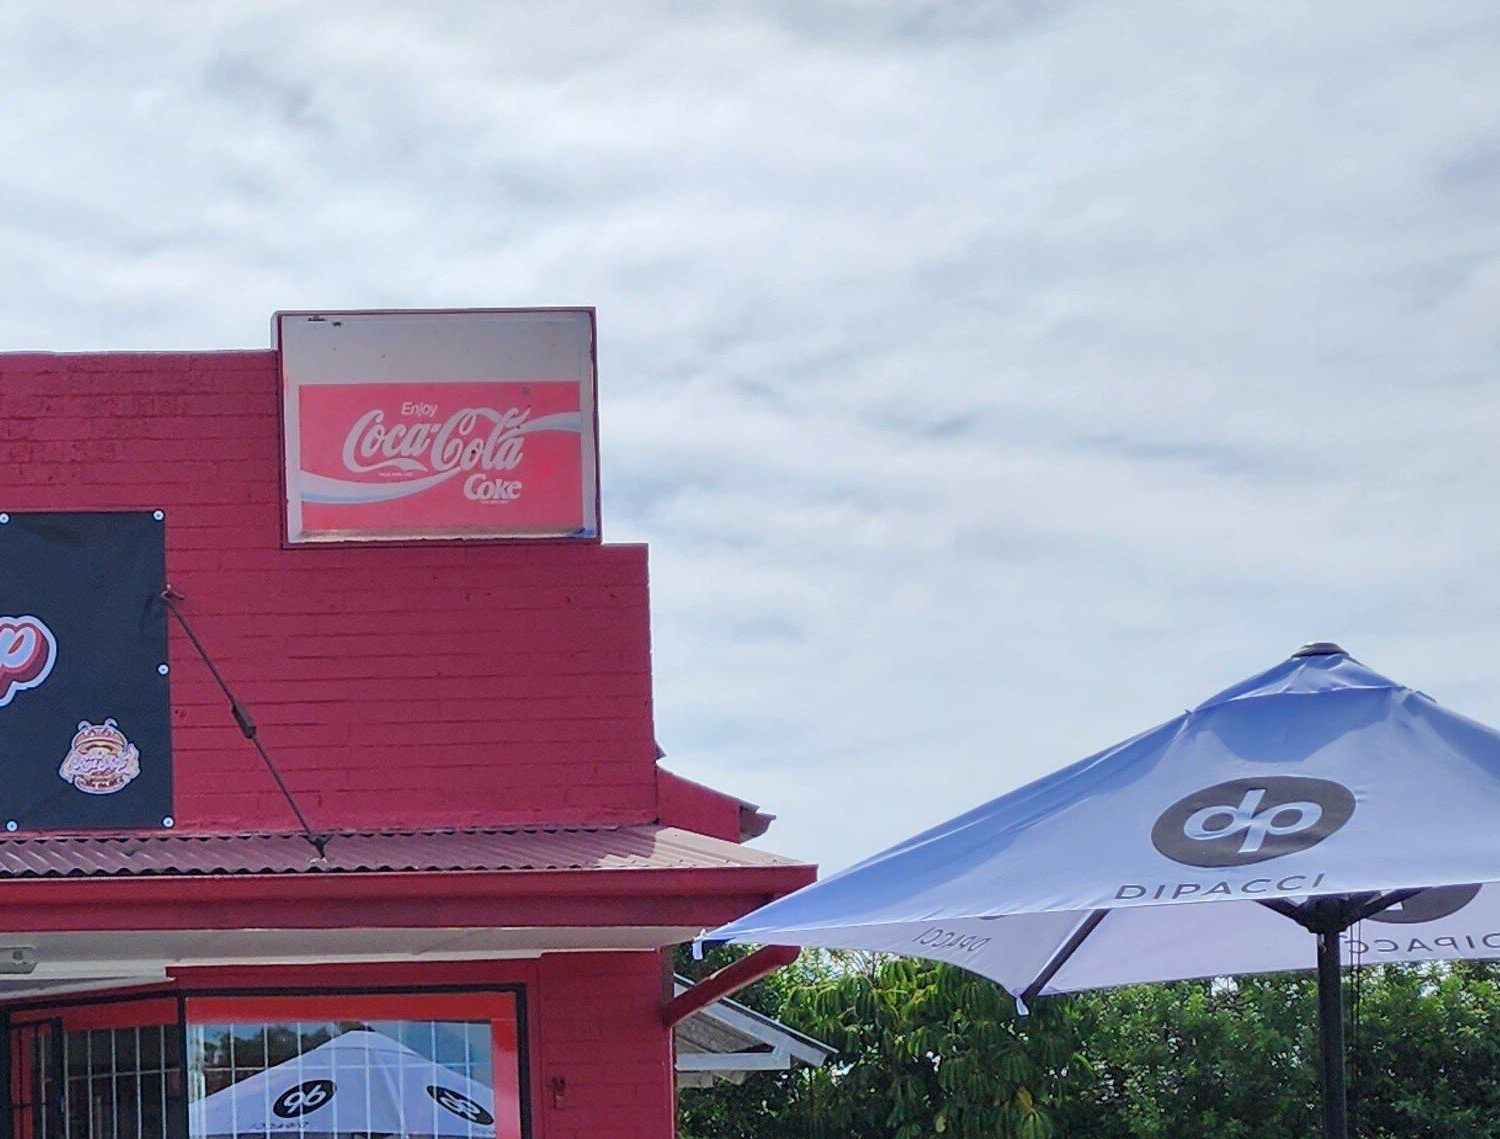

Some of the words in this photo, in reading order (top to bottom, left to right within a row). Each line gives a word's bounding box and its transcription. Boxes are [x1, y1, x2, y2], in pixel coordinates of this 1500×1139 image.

[401, 401, 438, 417] Enjoy
[342, 405, 532, 474] Coca-Cola
[463, 474, 523, 501] Coke
[1114, 872, 1326, 901] DIPACCI
